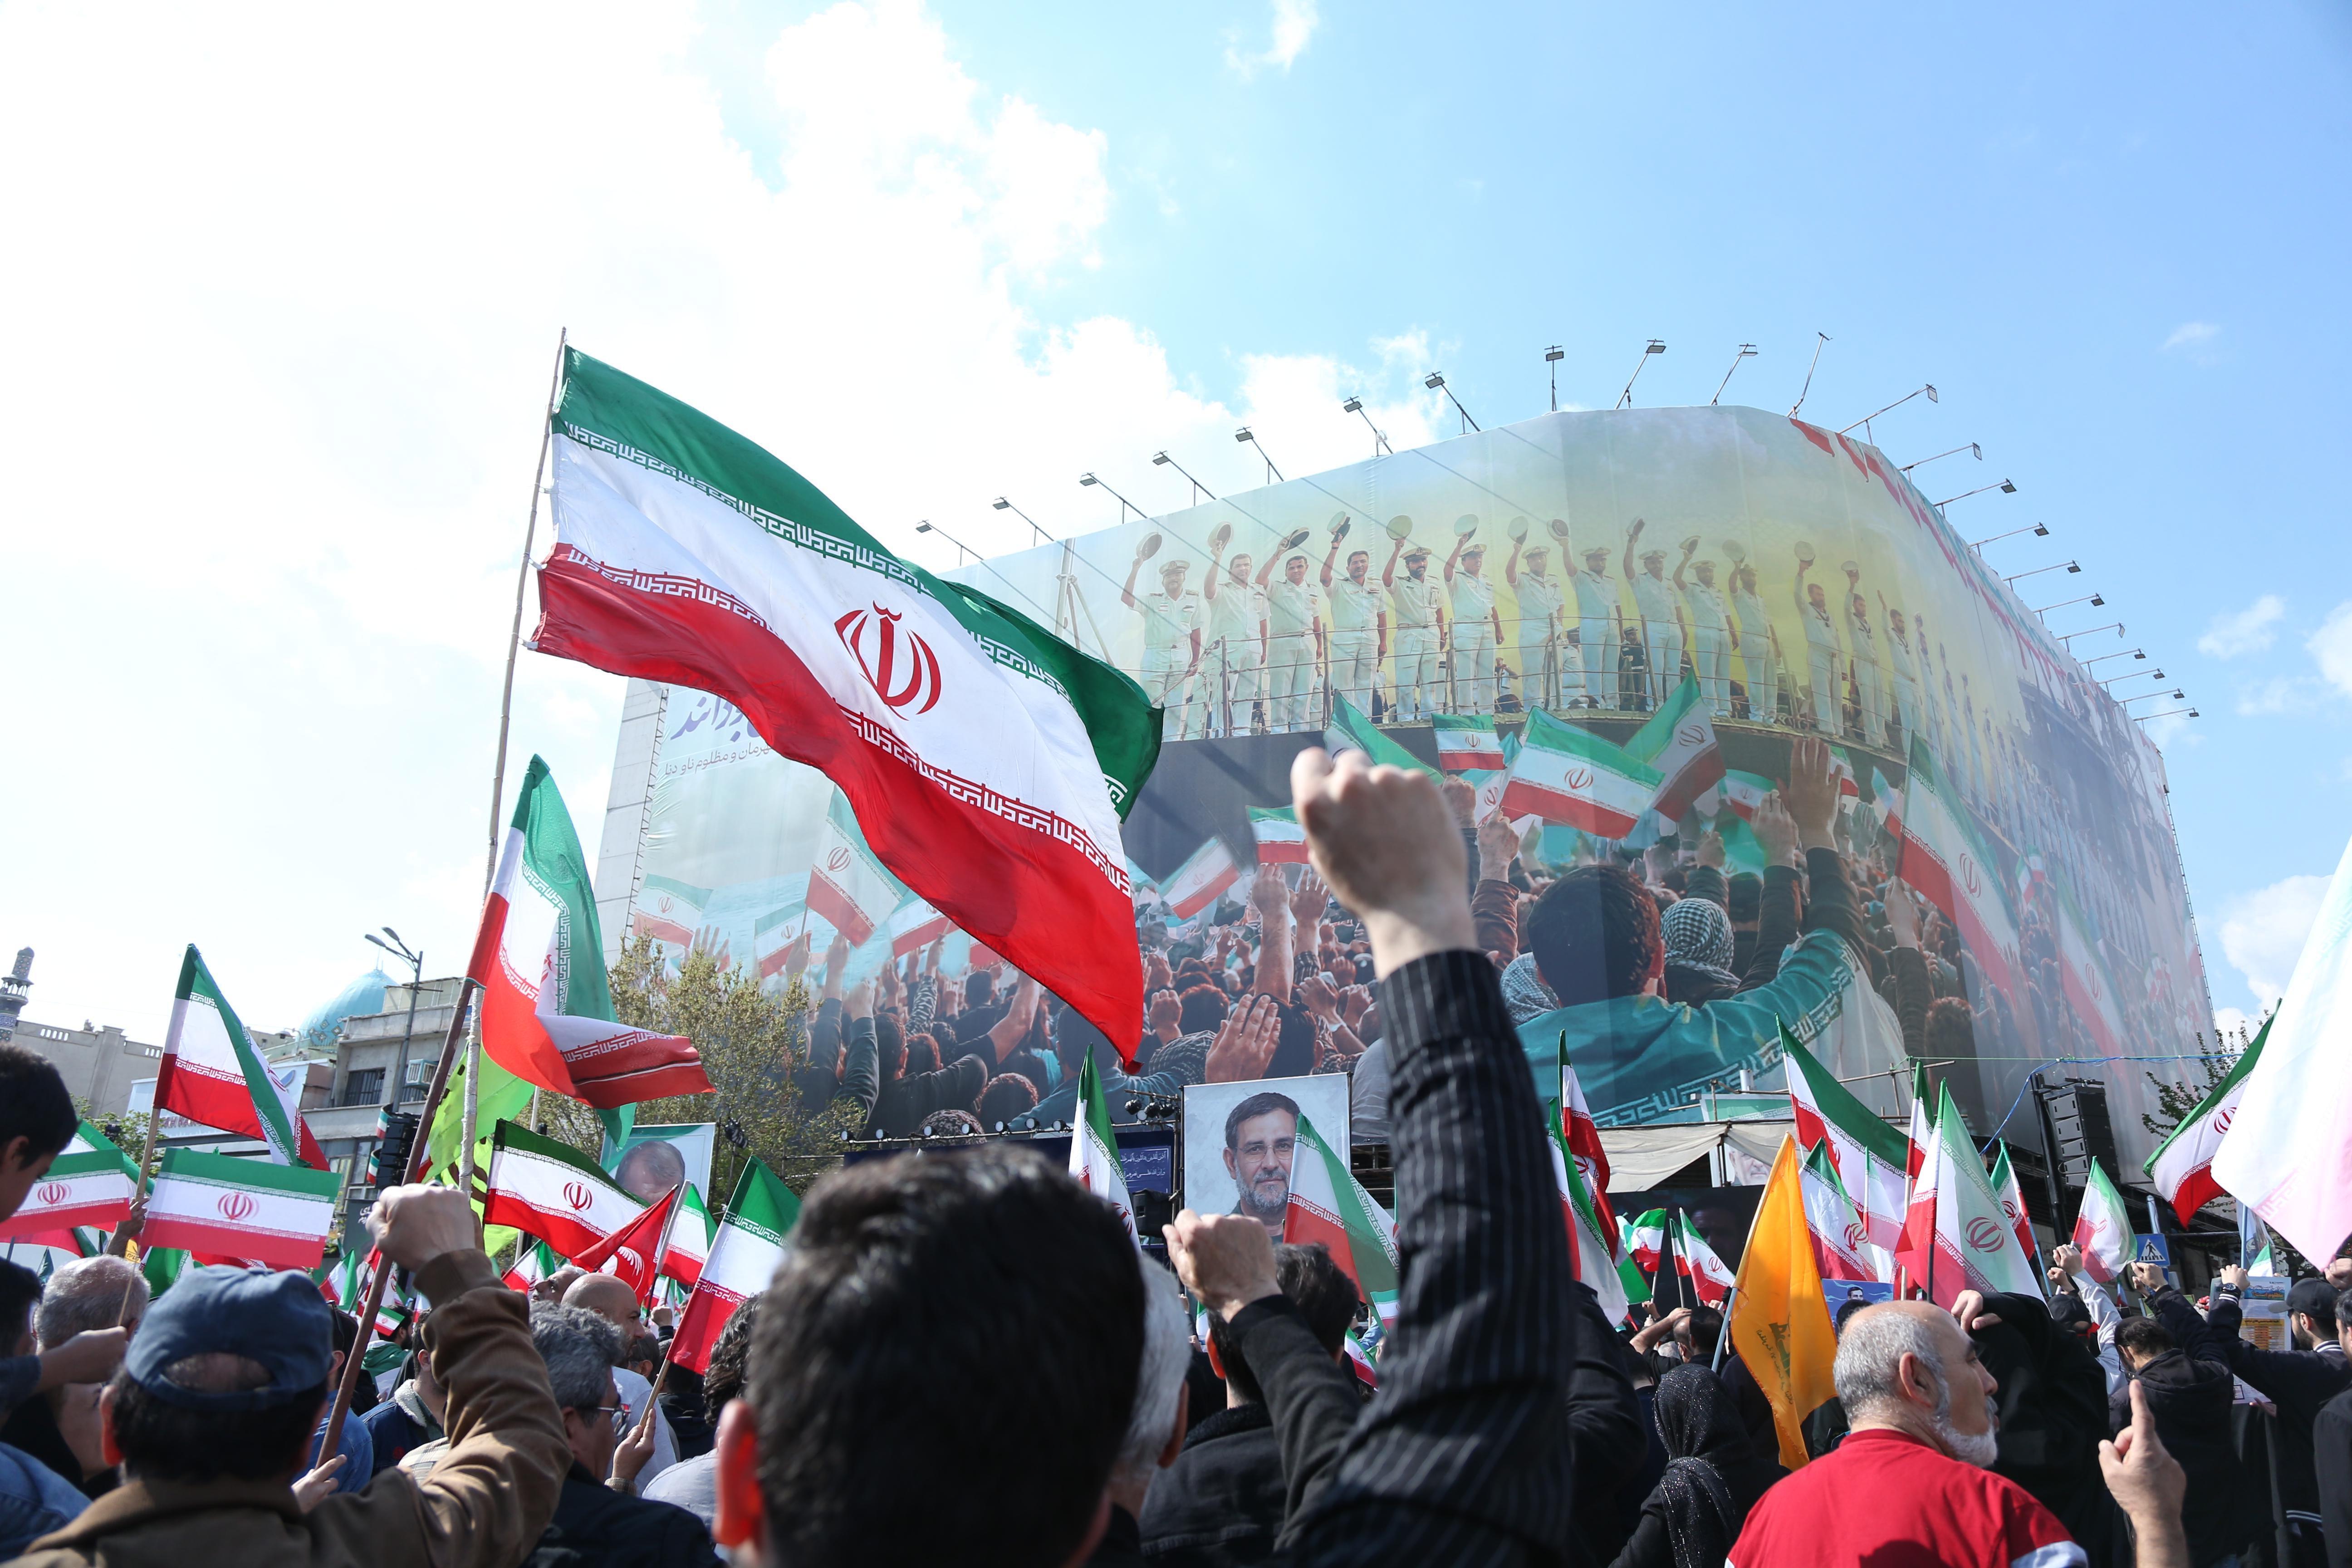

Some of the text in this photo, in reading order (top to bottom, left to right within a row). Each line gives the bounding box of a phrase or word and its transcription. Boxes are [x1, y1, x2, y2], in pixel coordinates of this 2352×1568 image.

[665, 742, 772, 775] هرمان و مظلوم ناو دنا
